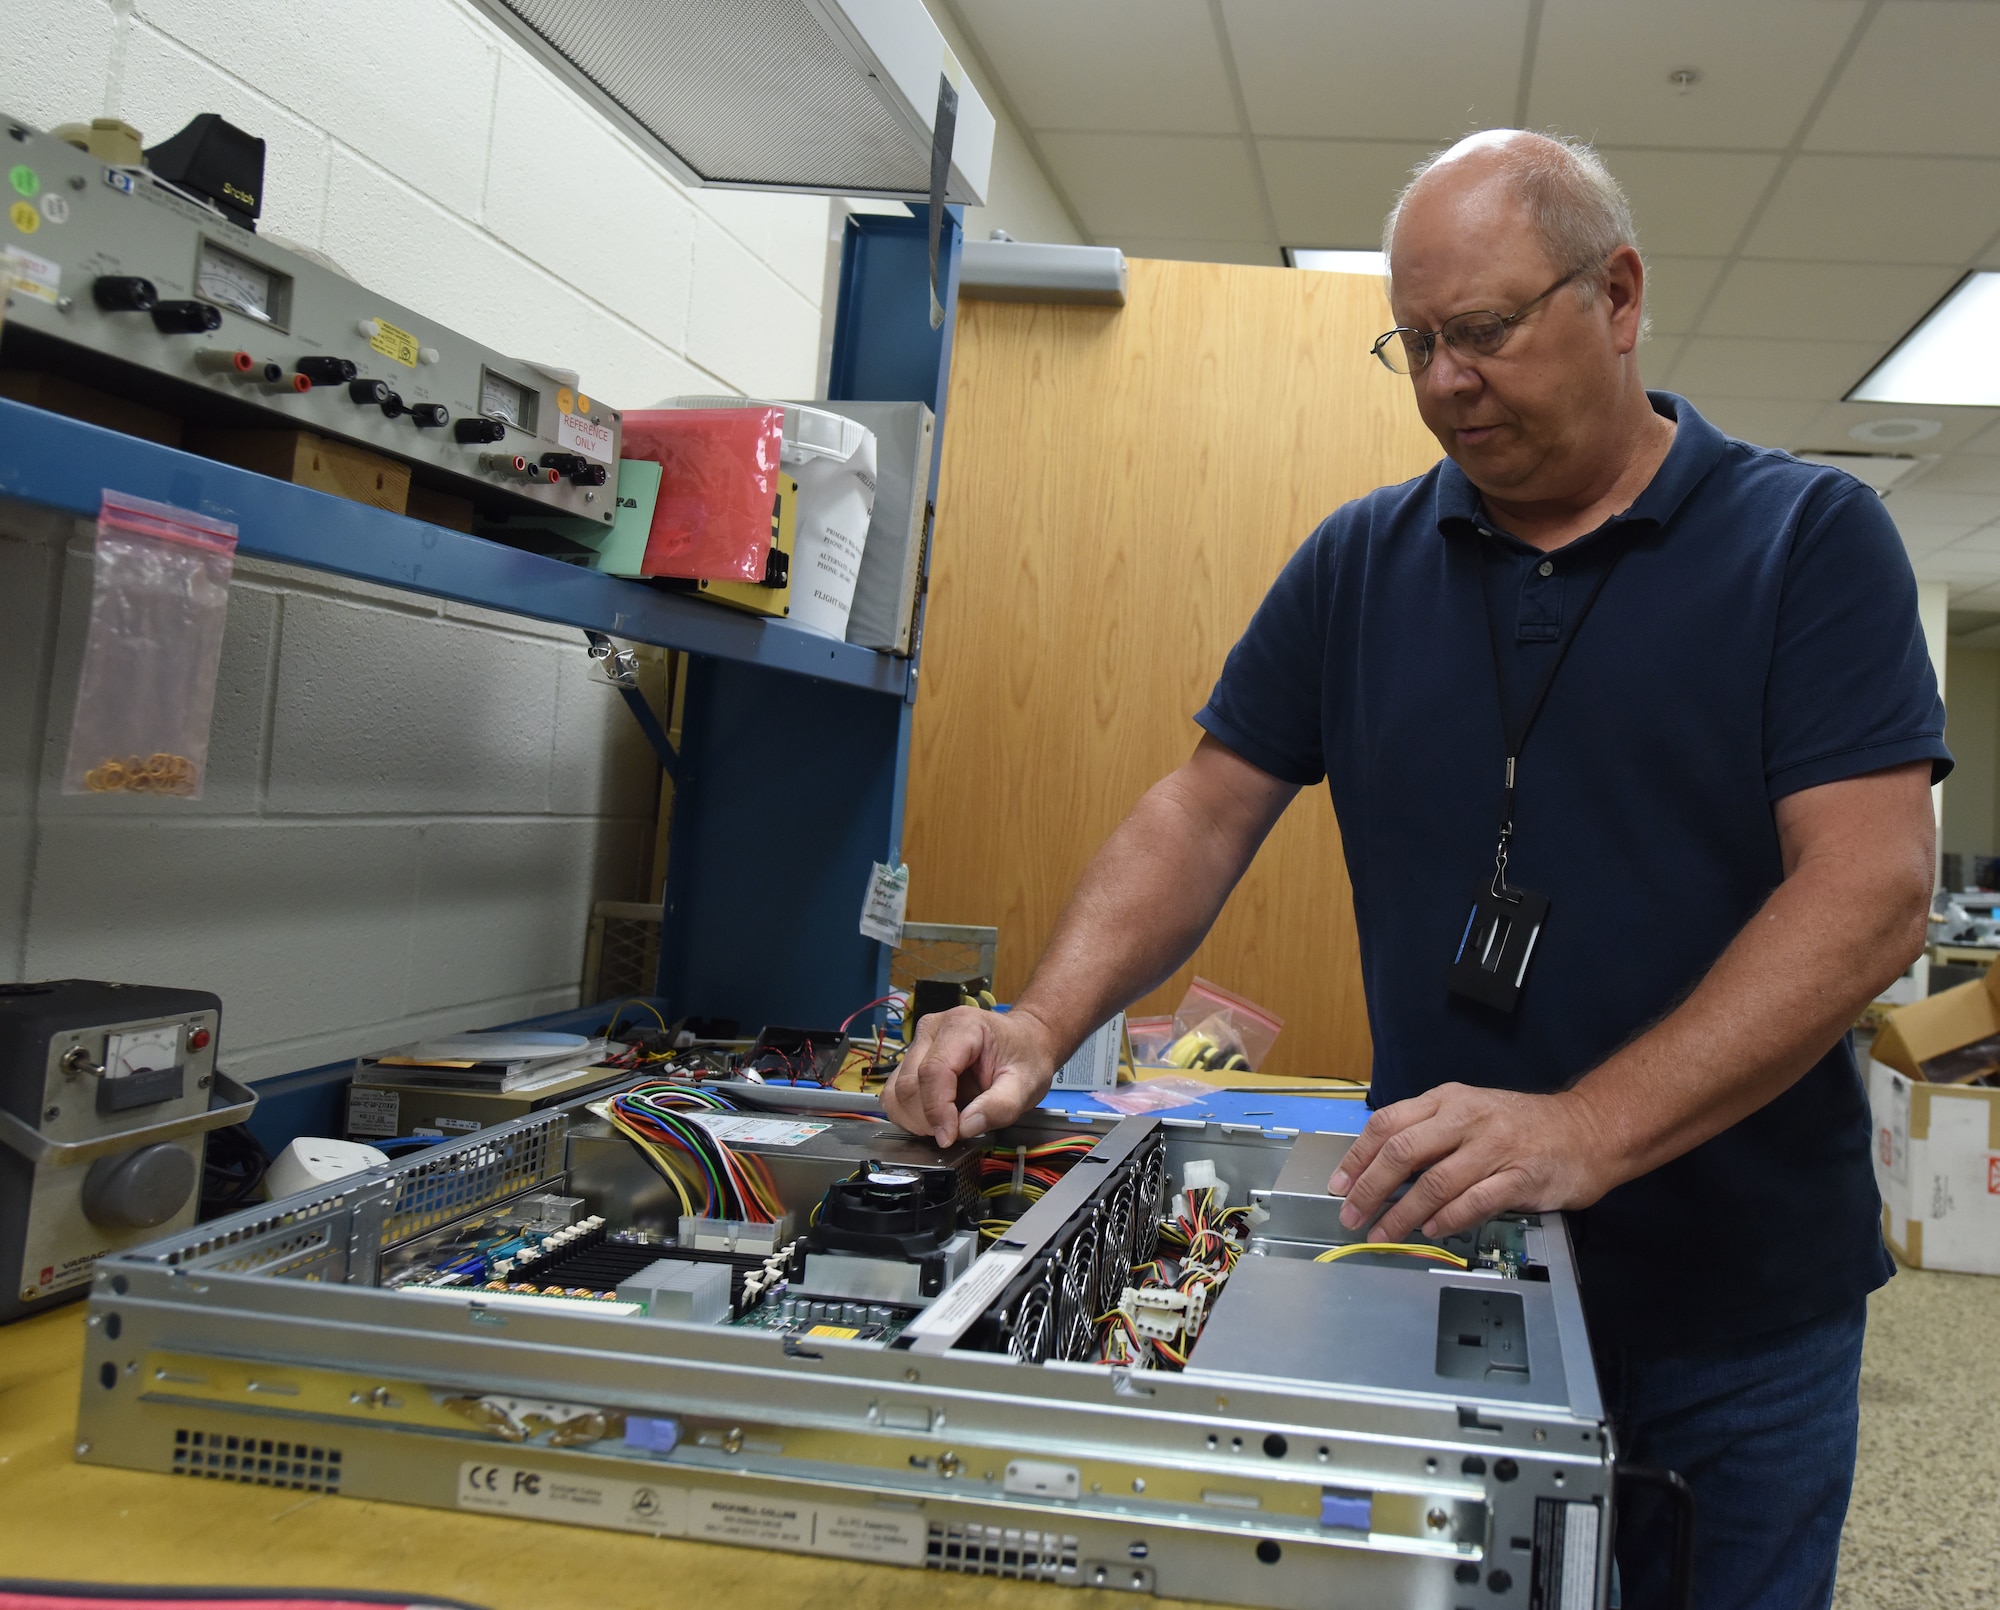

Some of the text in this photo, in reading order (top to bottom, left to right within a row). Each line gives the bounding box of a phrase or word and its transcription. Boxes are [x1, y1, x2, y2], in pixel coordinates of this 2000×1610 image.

[222, 182, 255, 206] Scotch
[564, 415, 608, 441] REFERENCE
[575, 435, 596, 451] ONLY
[814, 590, 838, 606] FLIGHT
[62, 1250, 106, 1269] VARIAC
[469, 1466, 499, 1492] CE
